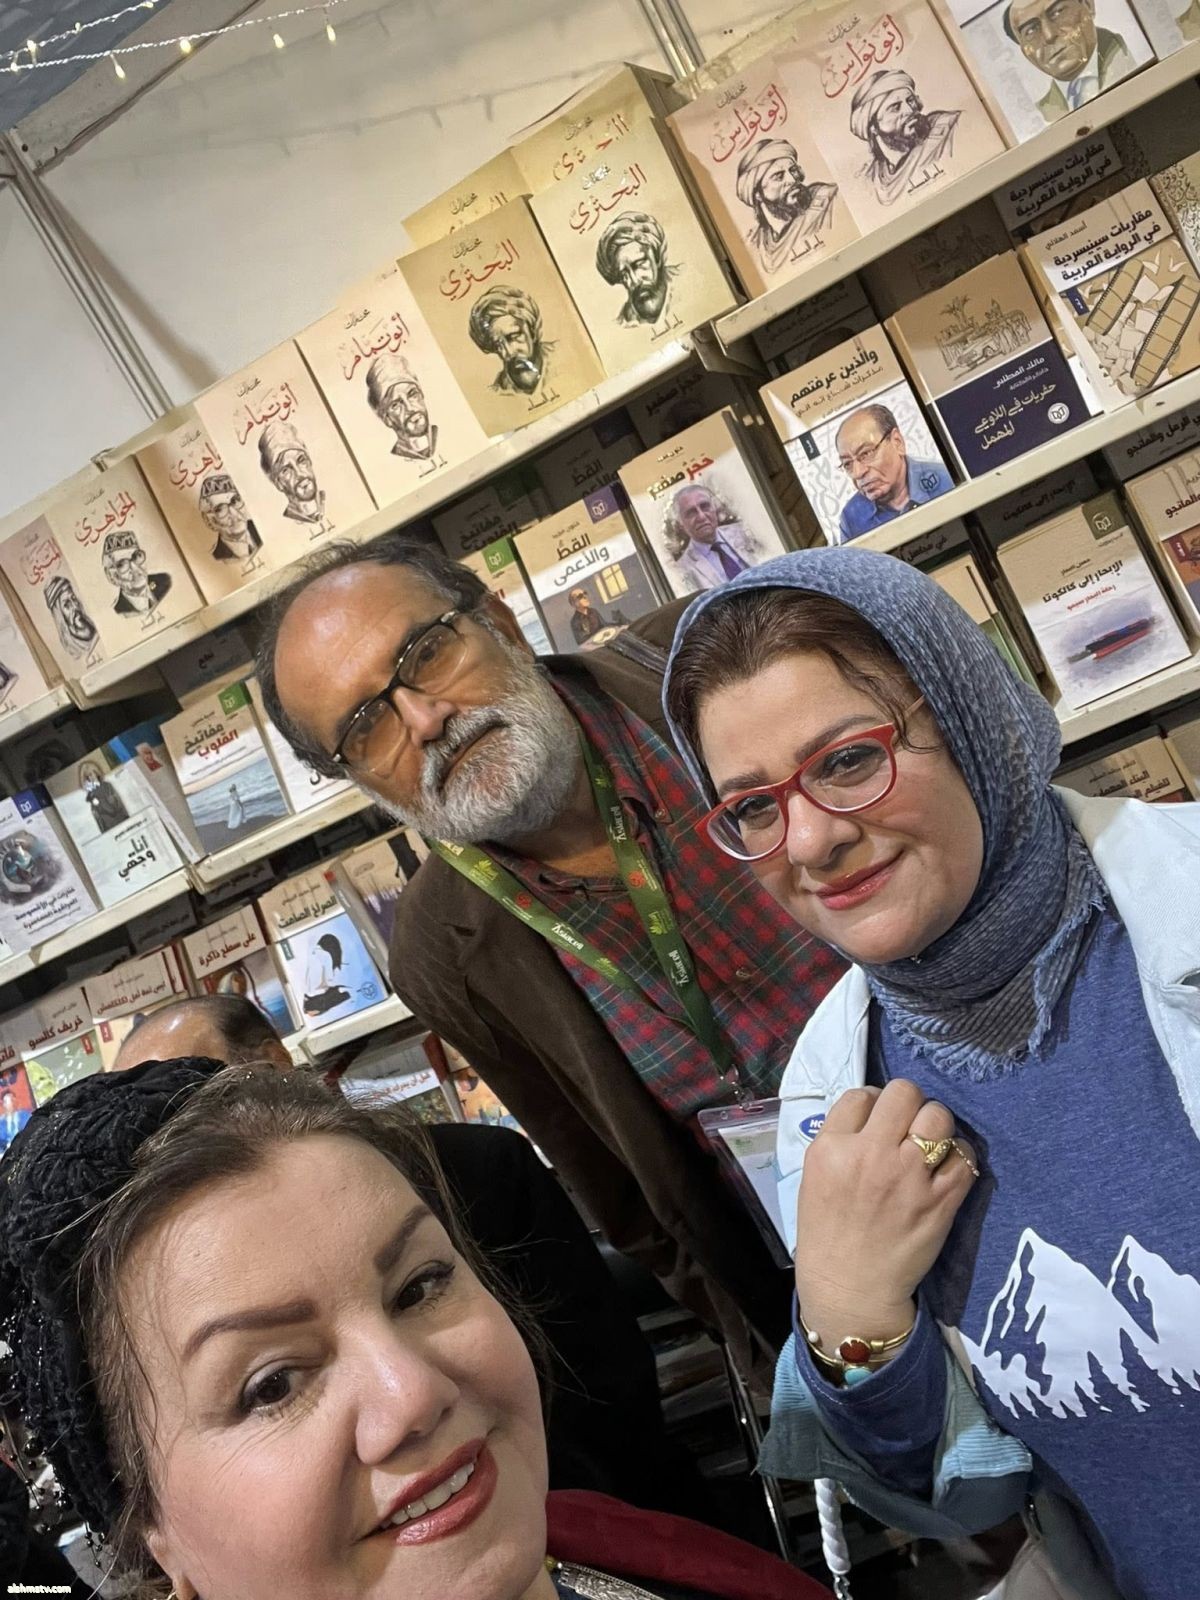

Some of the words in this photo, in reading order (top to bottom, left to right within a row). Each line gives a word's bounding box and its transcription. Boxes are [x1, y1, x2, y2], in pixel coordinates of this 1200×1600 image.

[875, 14, 904, 63] أبو
[823, 41, 876, 98] نواس
[761, 84, 788, 133] أبو
[711, 107, 763, 162] نواس
[1058, 166, 1093, 192] الرواية
[1096, 155, 1112, 178] في
[569, 163, 647, 235] البحتري
[1016, 187, 1057, 217] العربية
[1110, 210, 1152, 237] مقاربات
[1143, 222, 1161, 244] في
[1053, 235, 1109, 267] سينيسردية
[1103, 233, 1141, 259] الرواية
[439, 238, 520, 301] البحتري
[1061, 254, 1103, 281] العربية
[389, 312, 410, 352] أبو
[342, 337, 392, 381] تمام
[1026, 357, 1045, 370] مالك
[278, 382, 298, 420] أبو
[790, 372, 837, 408] عرفتهم
[1002, 397, 1024, 416] في
[236, 404, 282, 445] تمام
[981, 420, 1015, 450] المهمل
[75, 491, 137, 548] الجواهري
[554, 547, 610, 587] والأعمى
[1078, 574, 1095, 588] إلى
[1094, 560, 1123, 581] الإبحار
[1042, 582, 1076, 603] كالكوتا
[184, 724, 228, 755] مفاتيح
[196, 729, 238, 759] القلوب
[118, 850, 156, 882] وجهي
[278, 907, 311, 929] الصامت
[221, 942, 241, 958] سطح
[243, 932, 256, 948] على
[199, 950, 220, 967] ذاكرة
[57, 1015, 83, 1034] خريف
